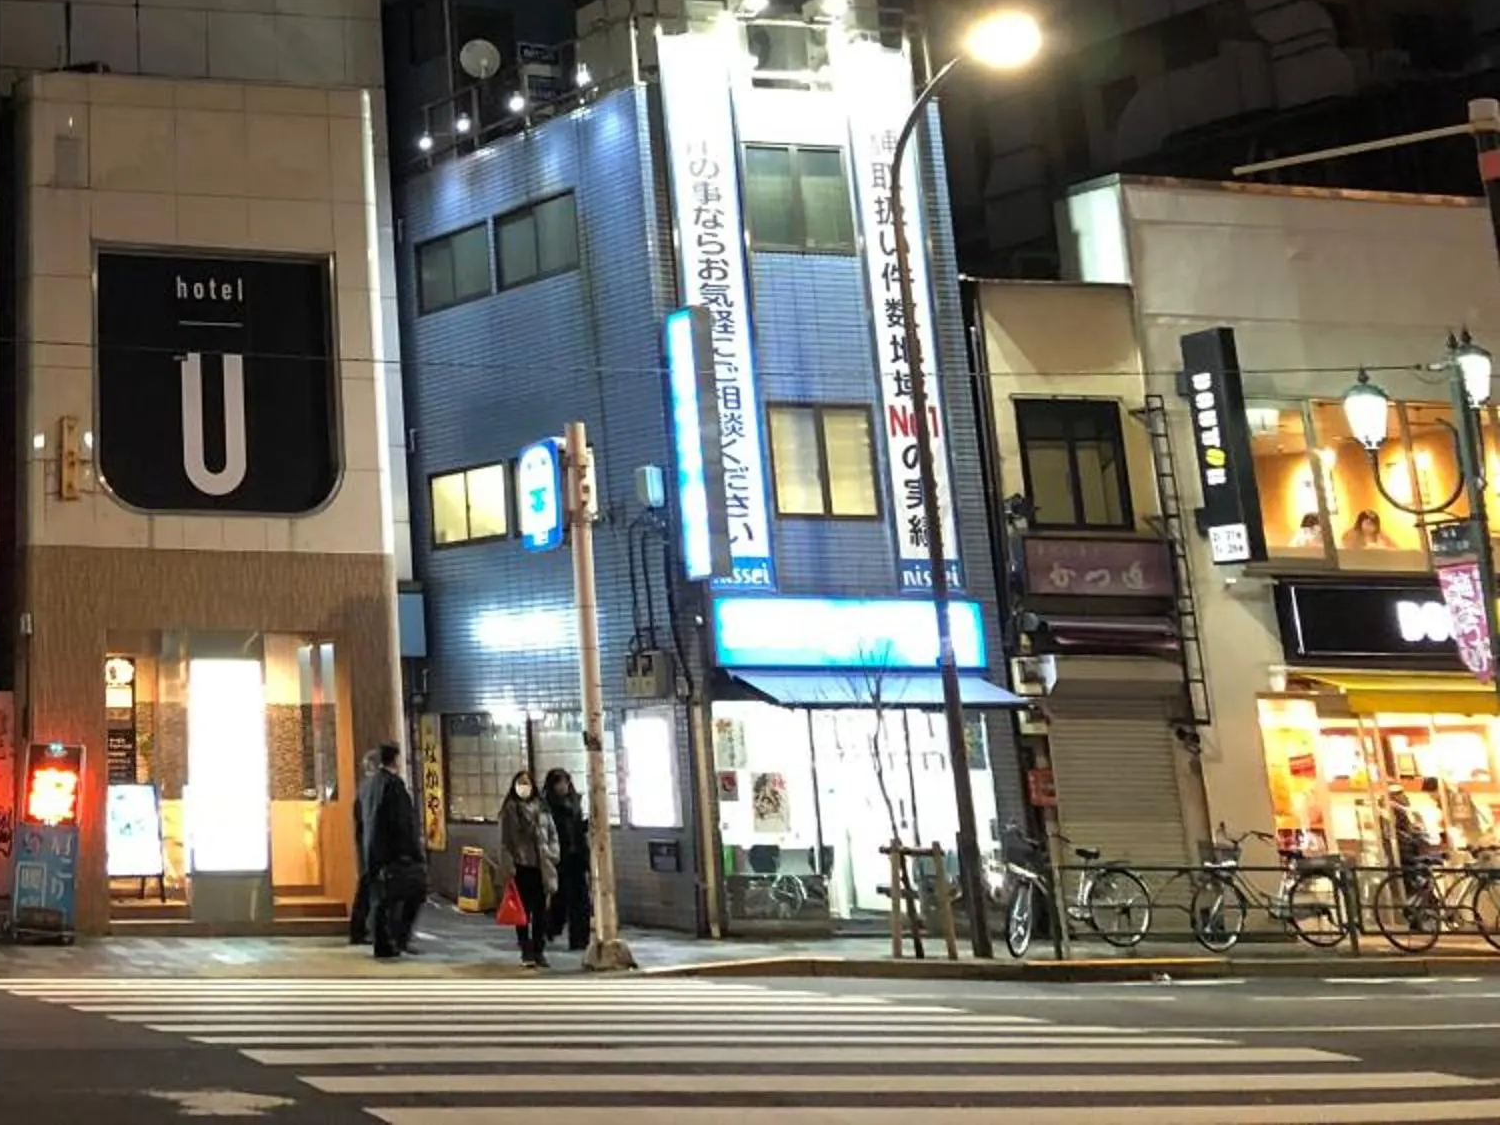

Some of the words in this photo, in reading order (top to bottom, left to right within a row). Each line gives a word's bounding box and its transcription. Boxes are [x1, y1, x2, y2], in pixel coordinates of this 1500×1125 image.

[176, 276, 244, 301] hotel
[181, 352, 247, 496] U
[902, 564, 961, 587] nisei
